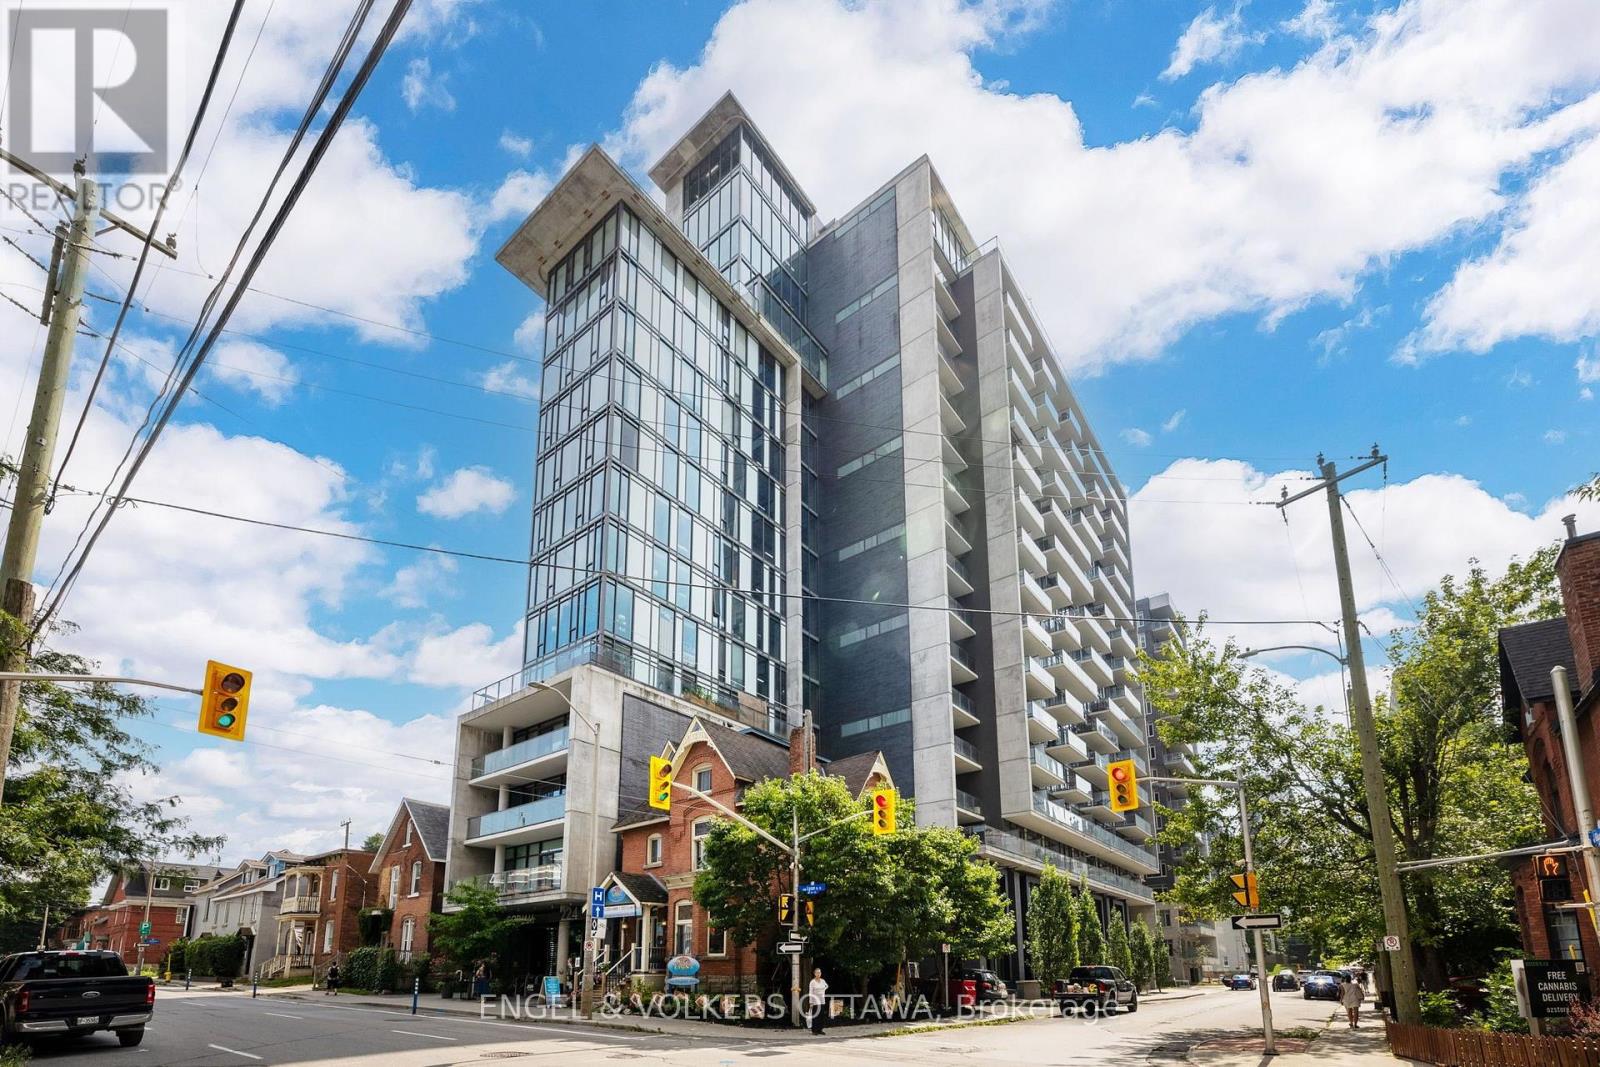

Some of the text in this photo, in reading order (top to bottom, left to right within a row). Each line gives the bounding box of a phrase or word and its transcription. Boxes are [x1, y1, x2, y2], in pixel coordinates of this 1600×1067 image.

[594, 891, 603, 901] H
[1547, 971, 1567, 980] FREE
[1538, 982, 1578, 991] CANNABIS
[1542, 993, 1578, 1002] DELIVERY
